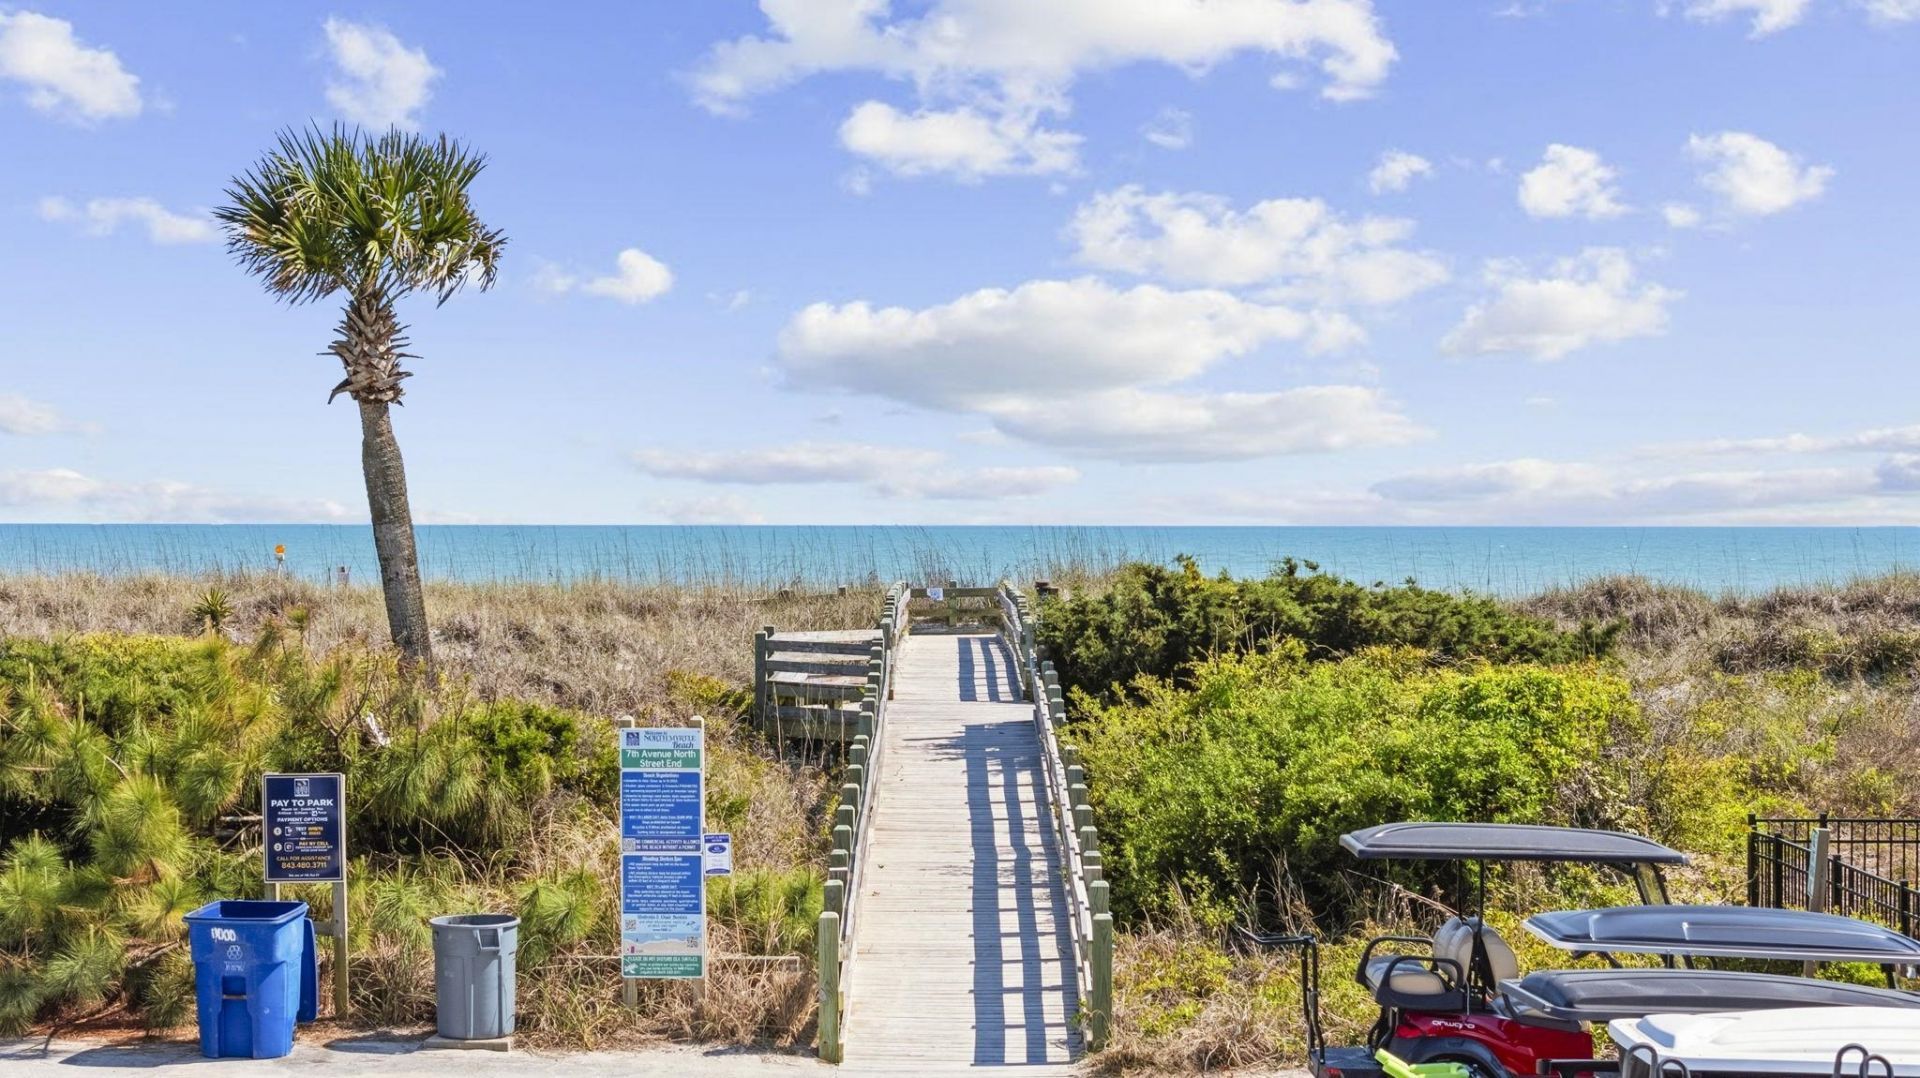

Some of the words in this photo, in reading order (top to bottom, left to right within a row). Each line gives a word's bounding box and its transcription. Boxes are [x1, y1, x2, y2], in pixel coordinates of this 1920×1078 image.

[672, 741, 694, 749] Beach
[626, 749, 639, 758] 7th
[641, 749, 671, 758] Avenue
[673, 749, 697, 758] North
[640, 760, 666, 768] Street
[667, 760, 682, 768] End
